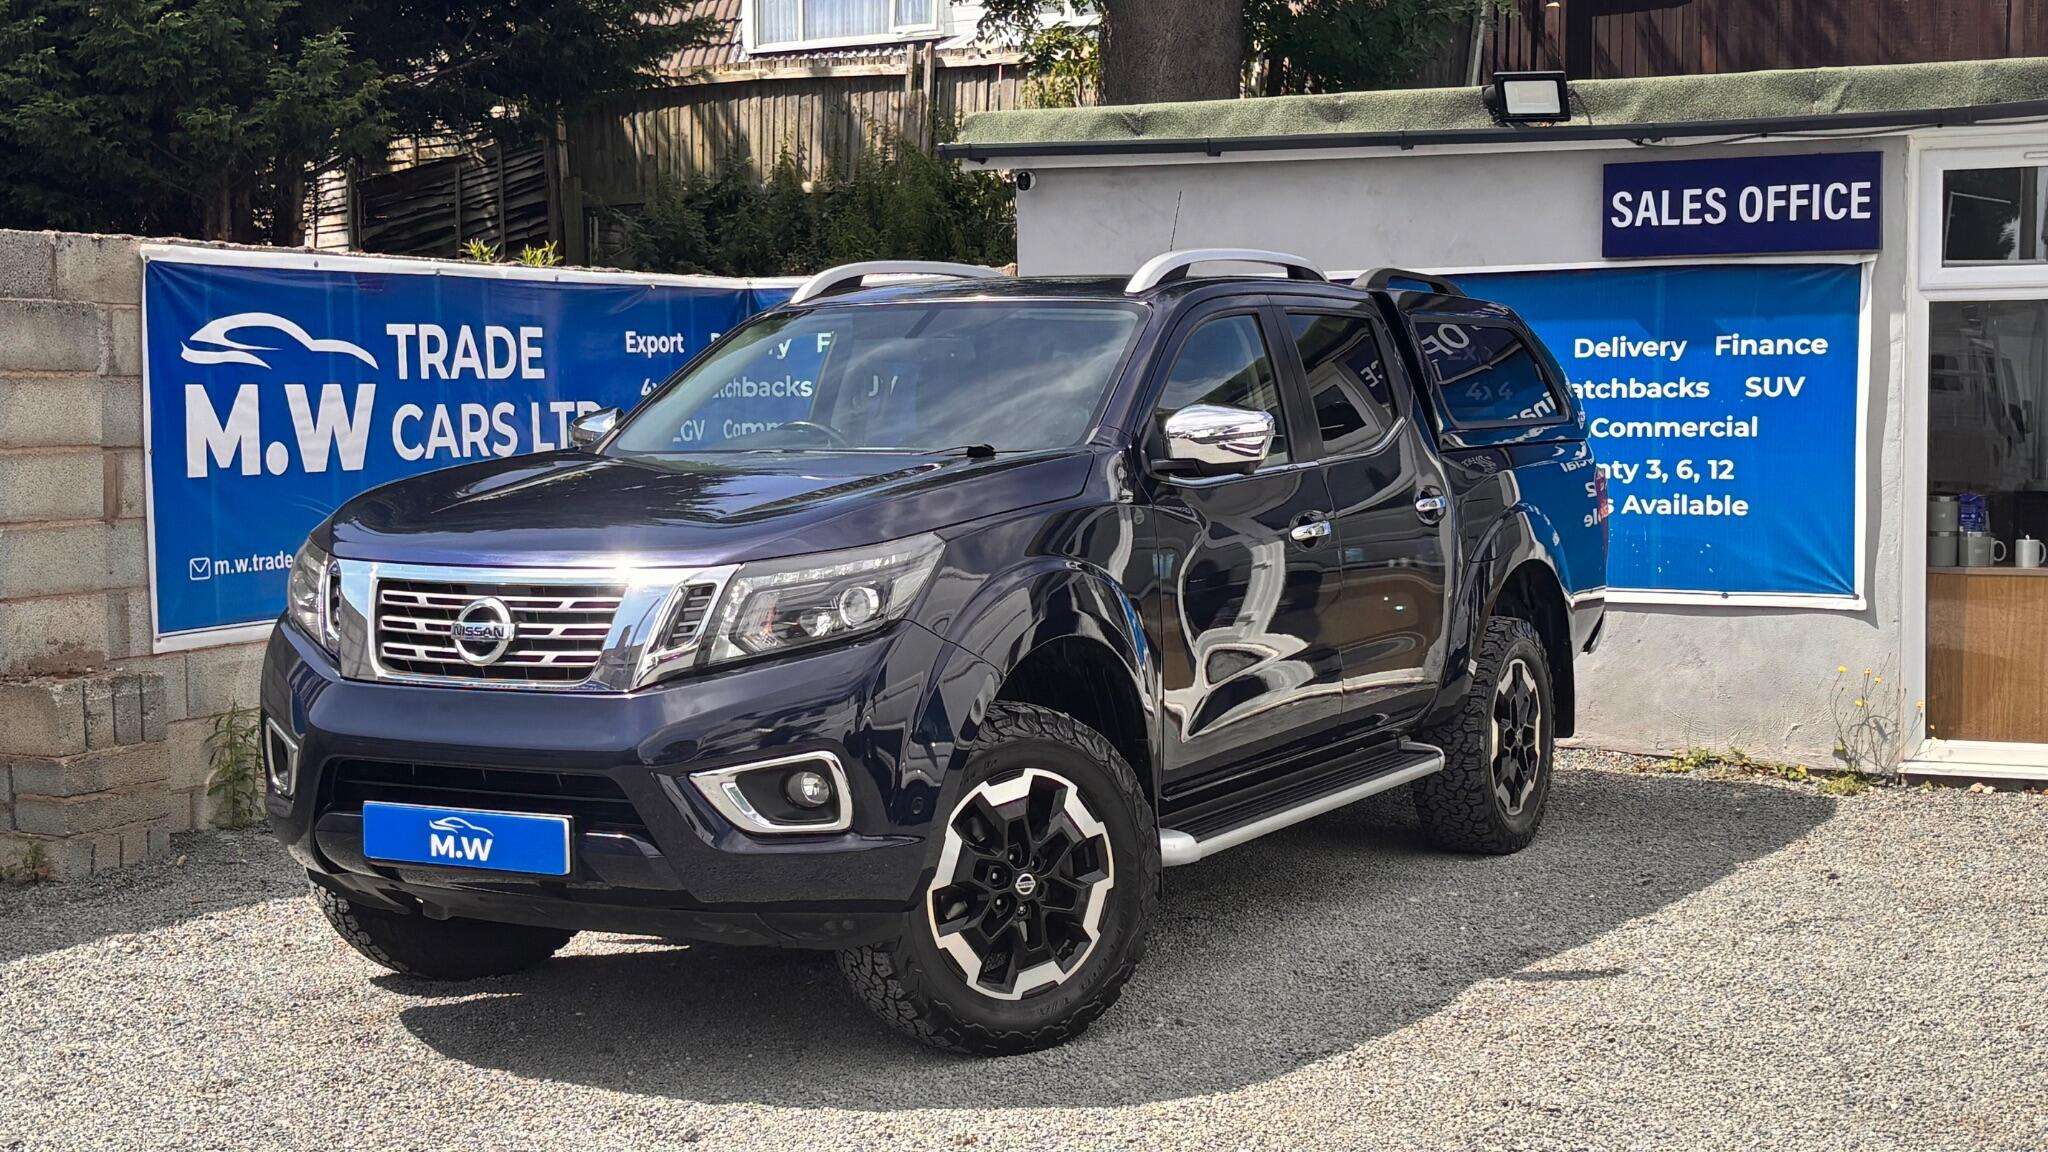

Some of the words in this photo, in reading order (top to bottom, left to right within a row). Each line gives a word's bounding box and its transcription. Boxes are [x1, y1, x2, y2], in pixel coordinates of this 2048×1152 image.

[1610, 187, 1727, 228] SALES
[1738, 181, 1871, 224] OFFICE
[386, 323, 545, 380] TRADE
[625, 331, 685, 358] Export
[1574, 336, 1687, 361] Delivery
[1715, 333, 1829, 356] Finance
[712, 375, 813, 399] chbacks
[1571, 377, 1710, 399] atchbacks
[1745, 376, 1806, 397] SUV
[185, 383, 377, 478] M.W
[391, 401, 519, 461] CARS
[1590, 414, 1758, 438] Commercial
[1645, 459, 1669, 481] 3,
[1676, 460, 1700, 483] 6,
[1707, 459, 1735, 479] 12
[1621, 493, 1749, 516] Available
[453, 625, 505, 639] NISSAN
[430, 833, 493, 862] M.W
